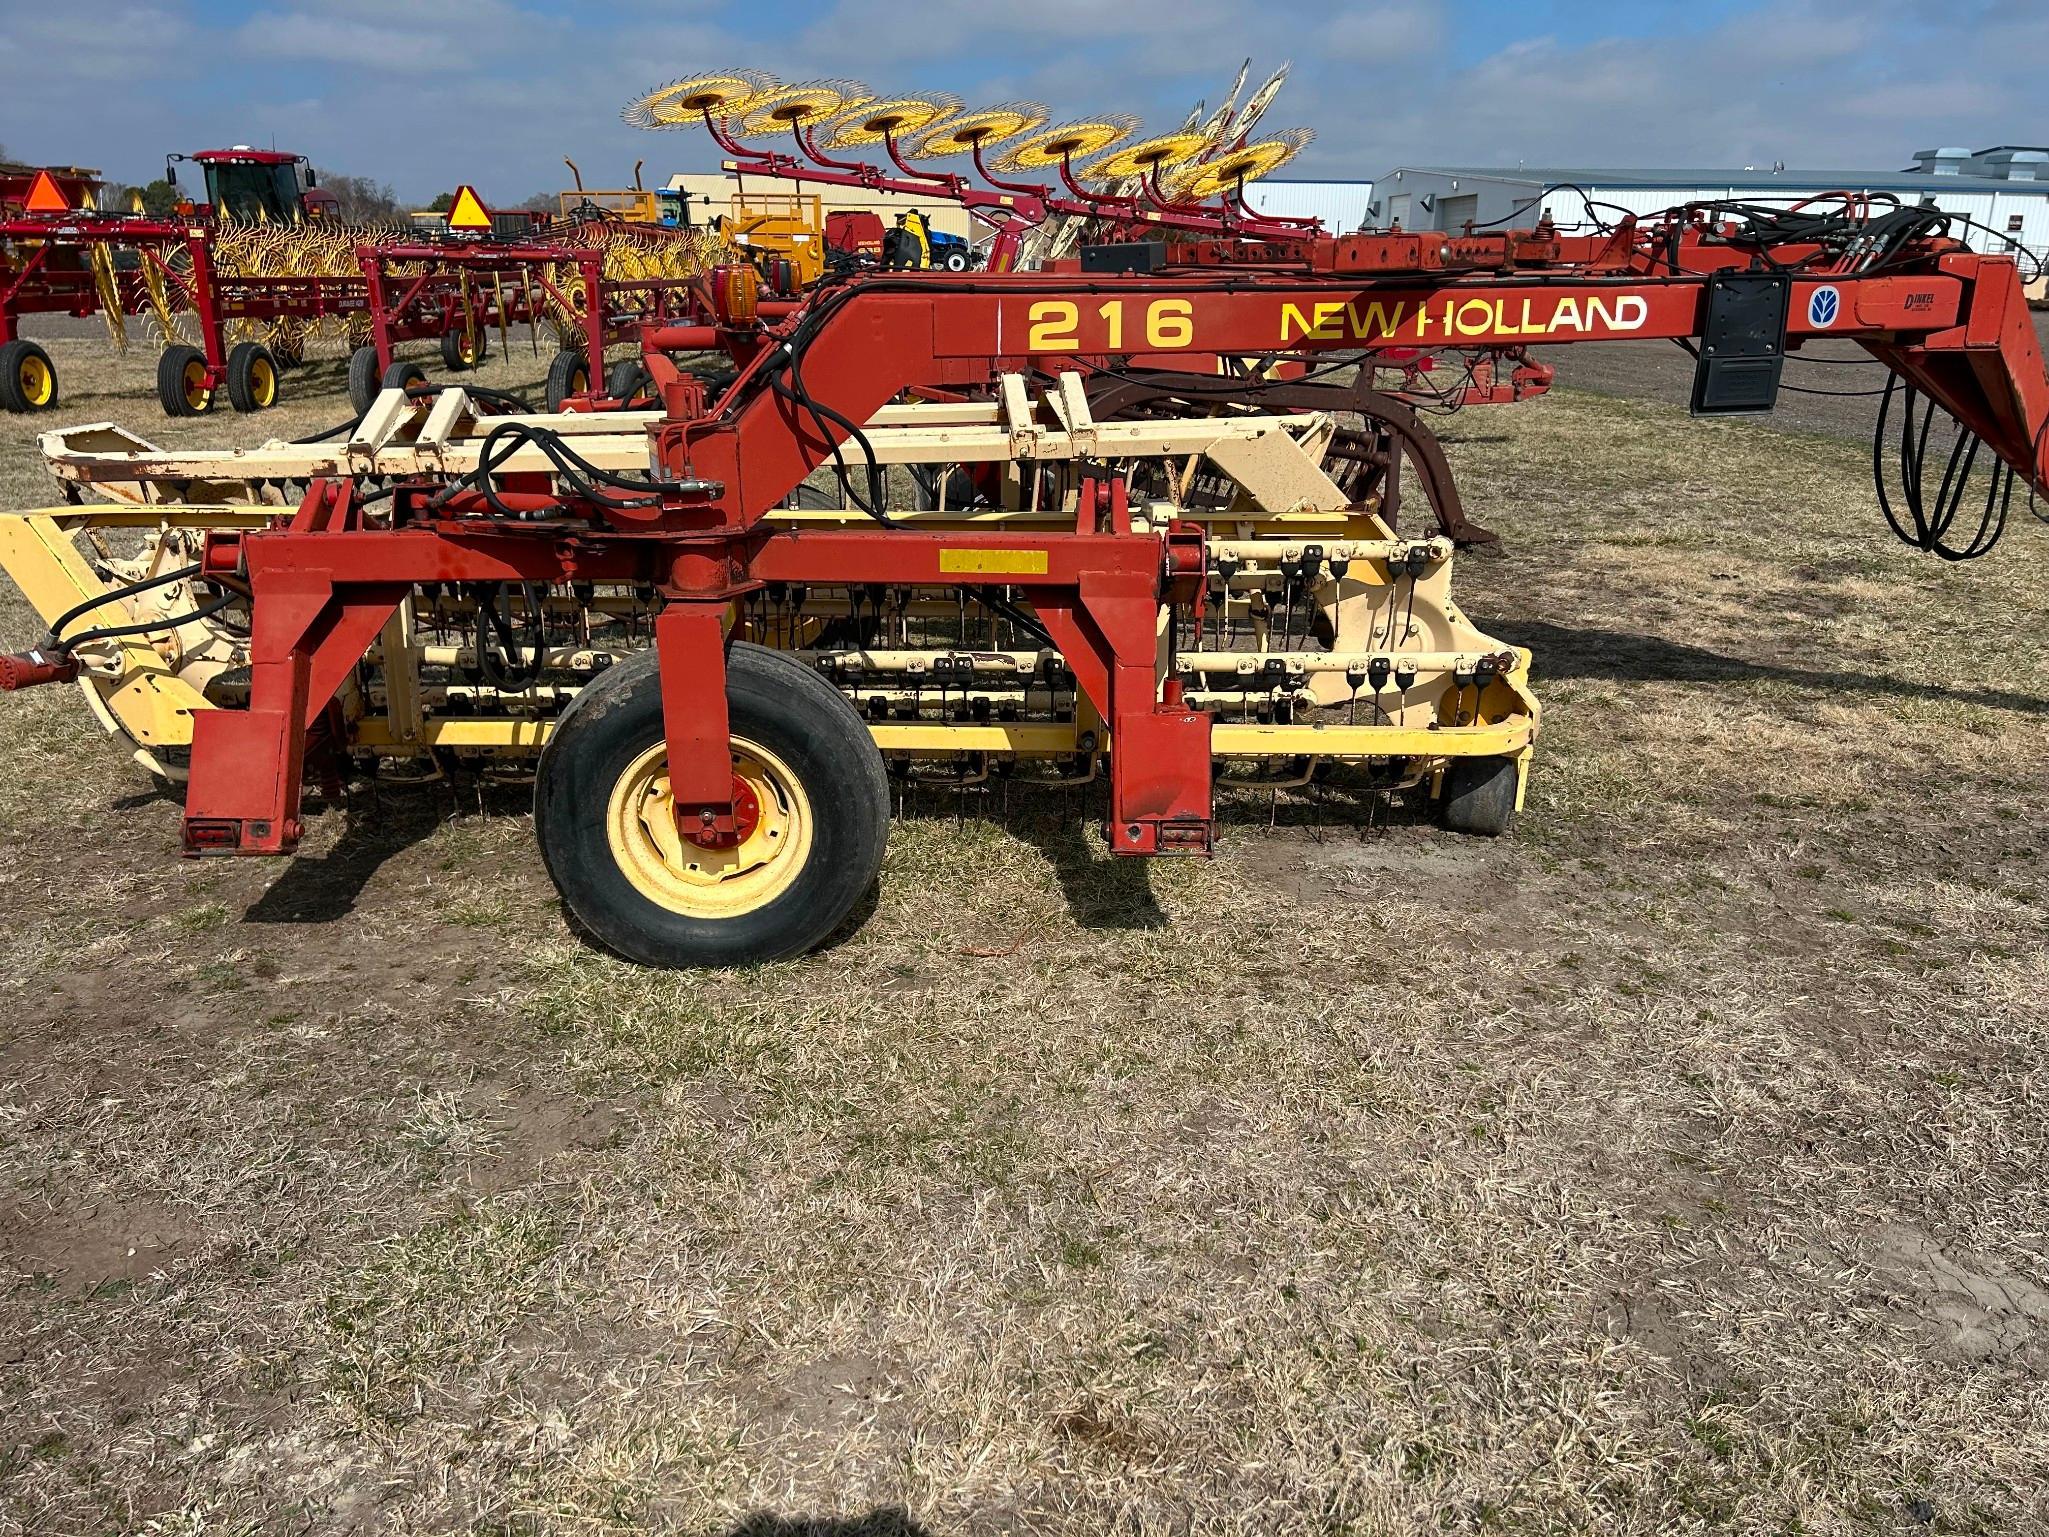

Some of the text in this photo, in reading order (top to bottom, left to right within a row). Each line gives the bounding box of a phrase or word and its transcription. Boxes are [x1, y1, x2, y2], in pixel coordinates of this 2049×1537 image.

[1029, 299, 1194, 350] 216
[1280, 295, 1648, 341] NEW HOLLAND
[1904, 294, 1935, 309] DINKEL
